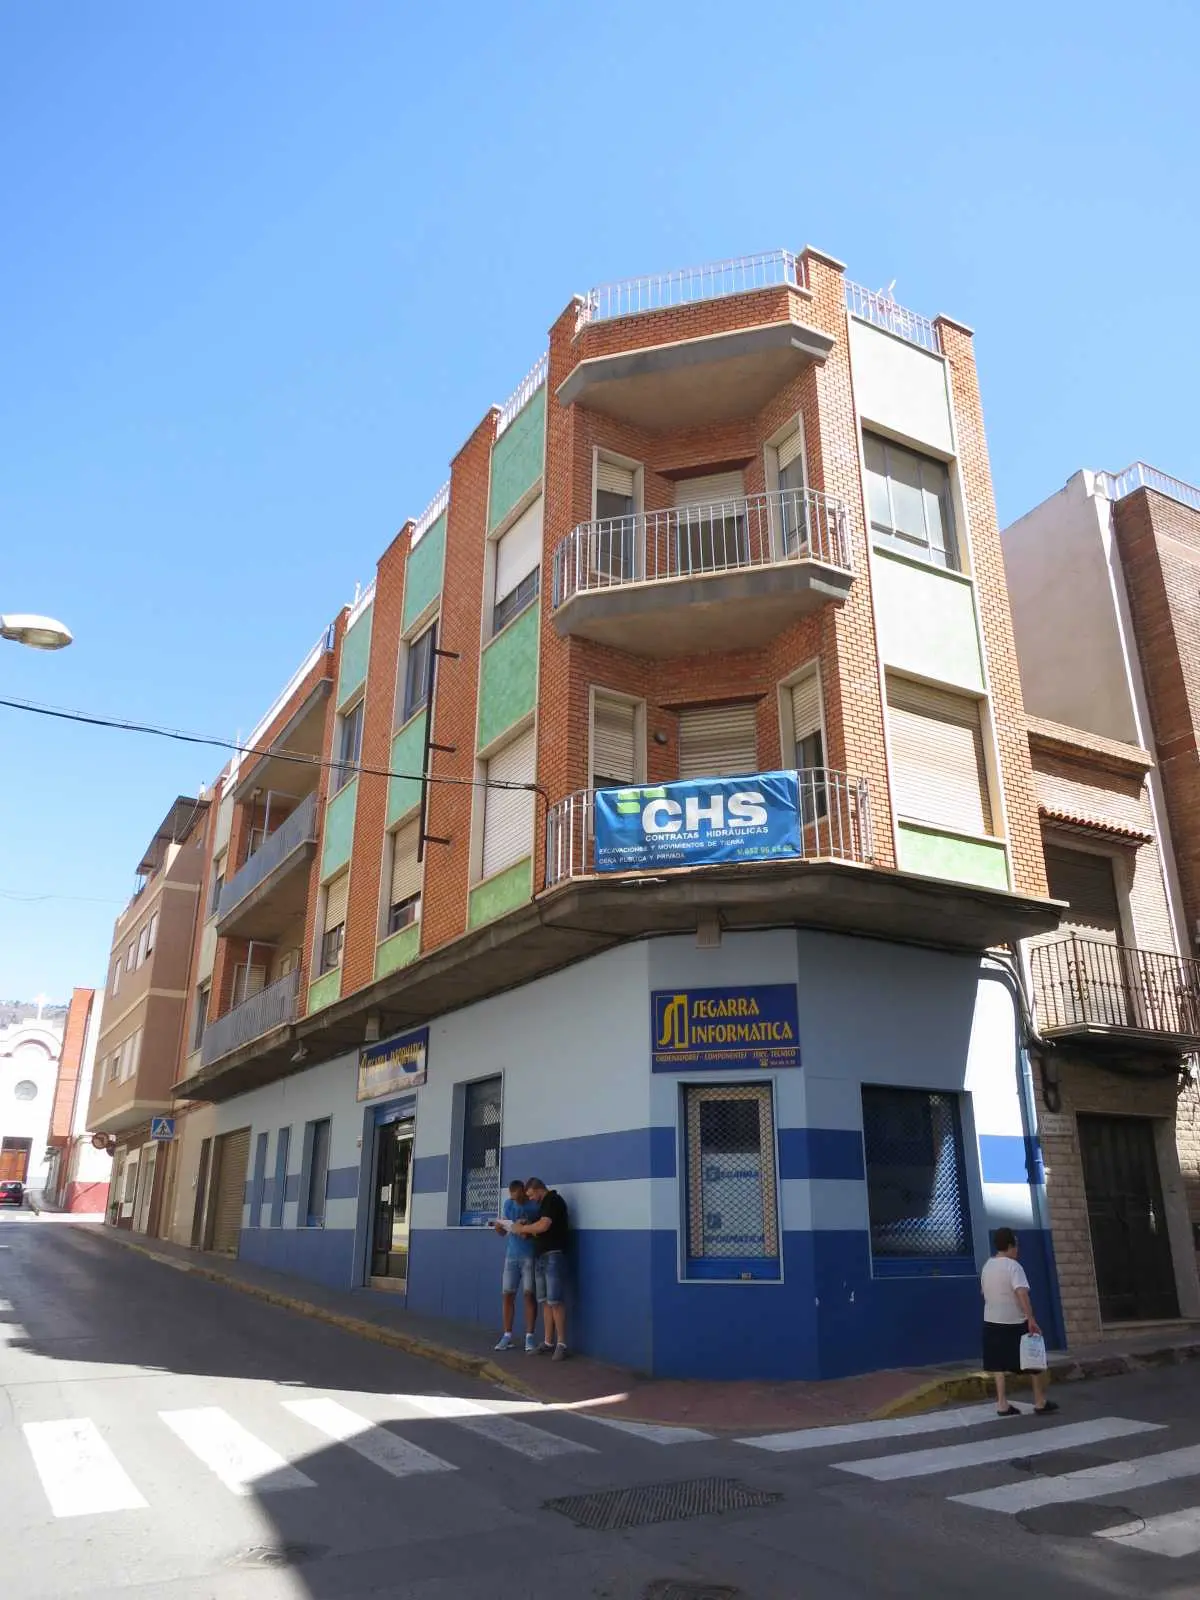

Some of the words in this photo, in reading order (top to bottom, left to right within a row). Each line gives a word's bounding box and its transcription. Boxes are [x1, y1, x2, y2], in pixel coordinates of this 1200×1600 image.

[642, 791, 768, 833] CHS
[645, 832, 699, 842] CONTRATAS
[658, 841, 704, 850] MOVIMIENTOS
[692, 997, 760, 1018] SEGARRA
[692, 1021, 793, 1044] INFORMATICA
